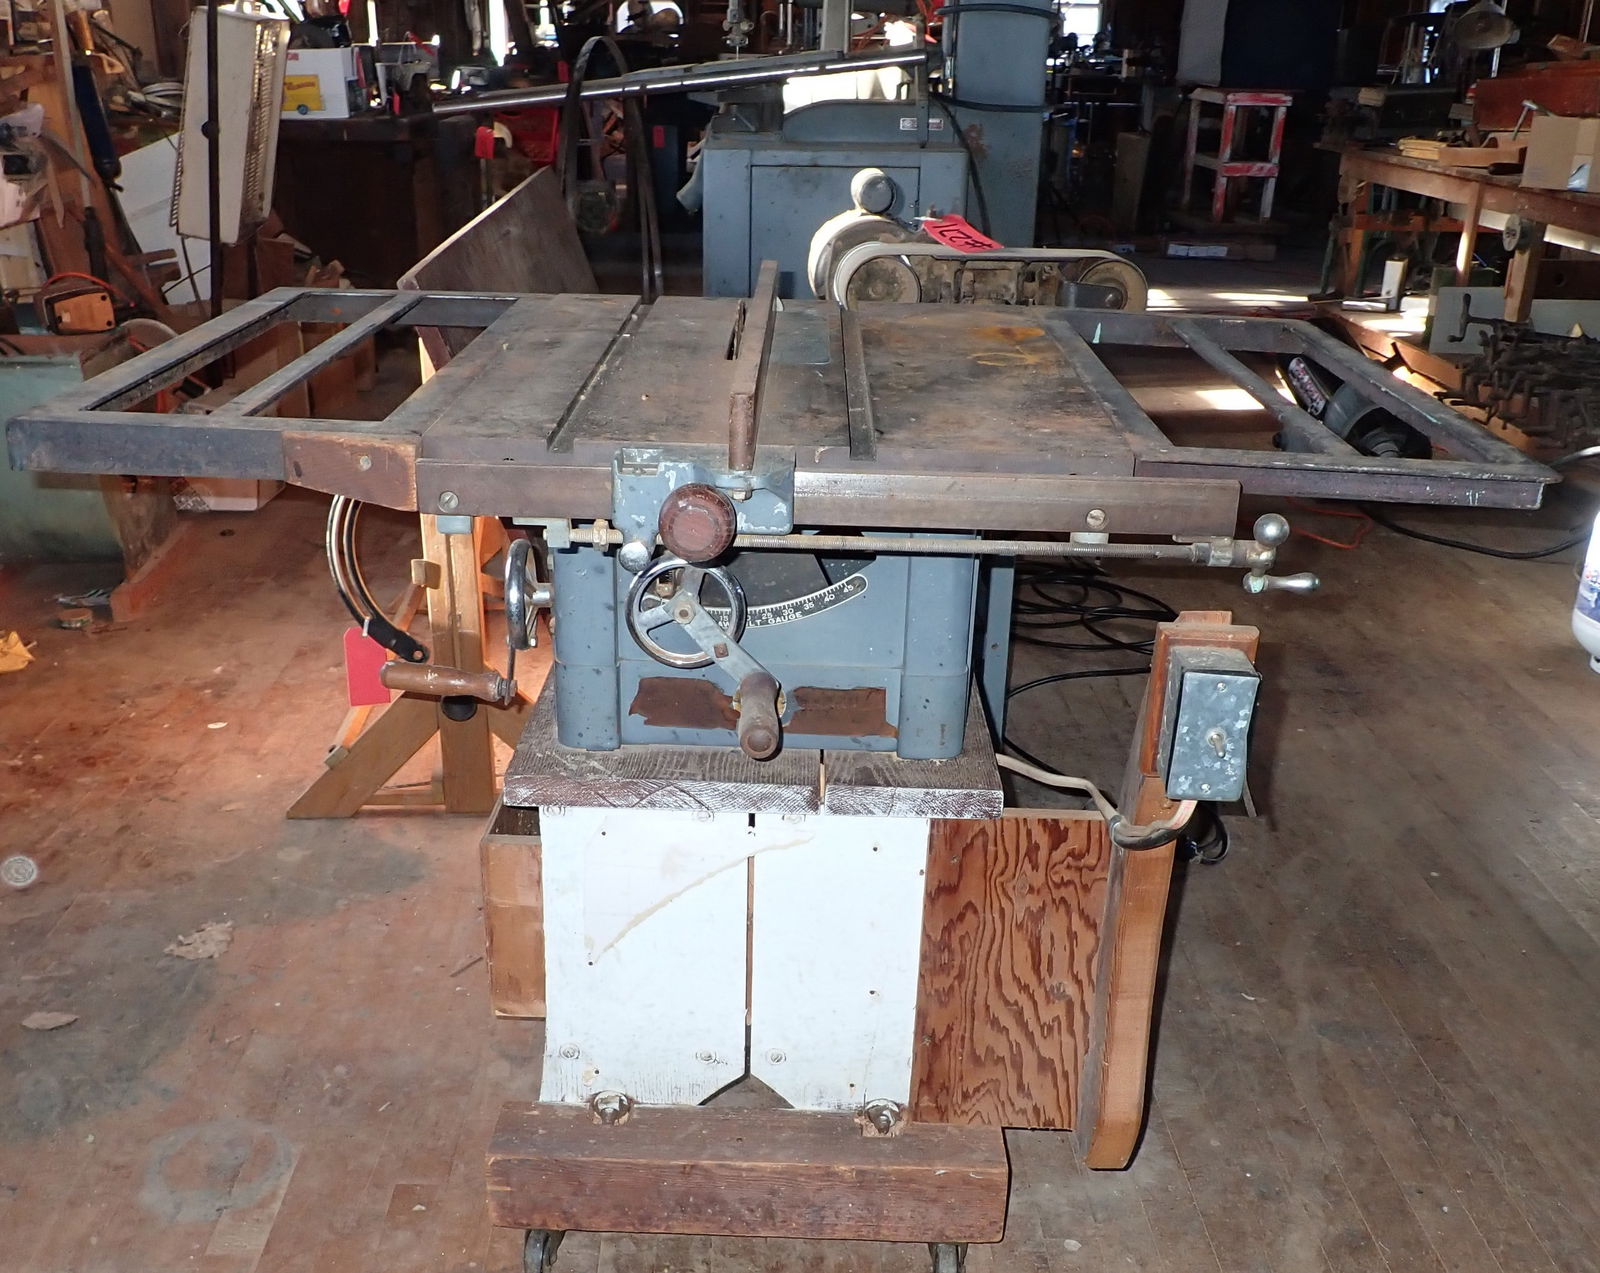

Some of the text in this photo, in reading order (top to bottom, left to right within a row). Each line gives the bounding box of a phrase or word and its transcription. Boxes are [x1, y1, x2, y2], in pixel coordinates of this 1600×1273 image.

[782, 608, 794, 616] 30
[803, 601, 815, 611] 35
[824, 594, 835, 603] 40
[843, 585, 854, 594] 45
[767, 611, 803, 625] GAUGE
